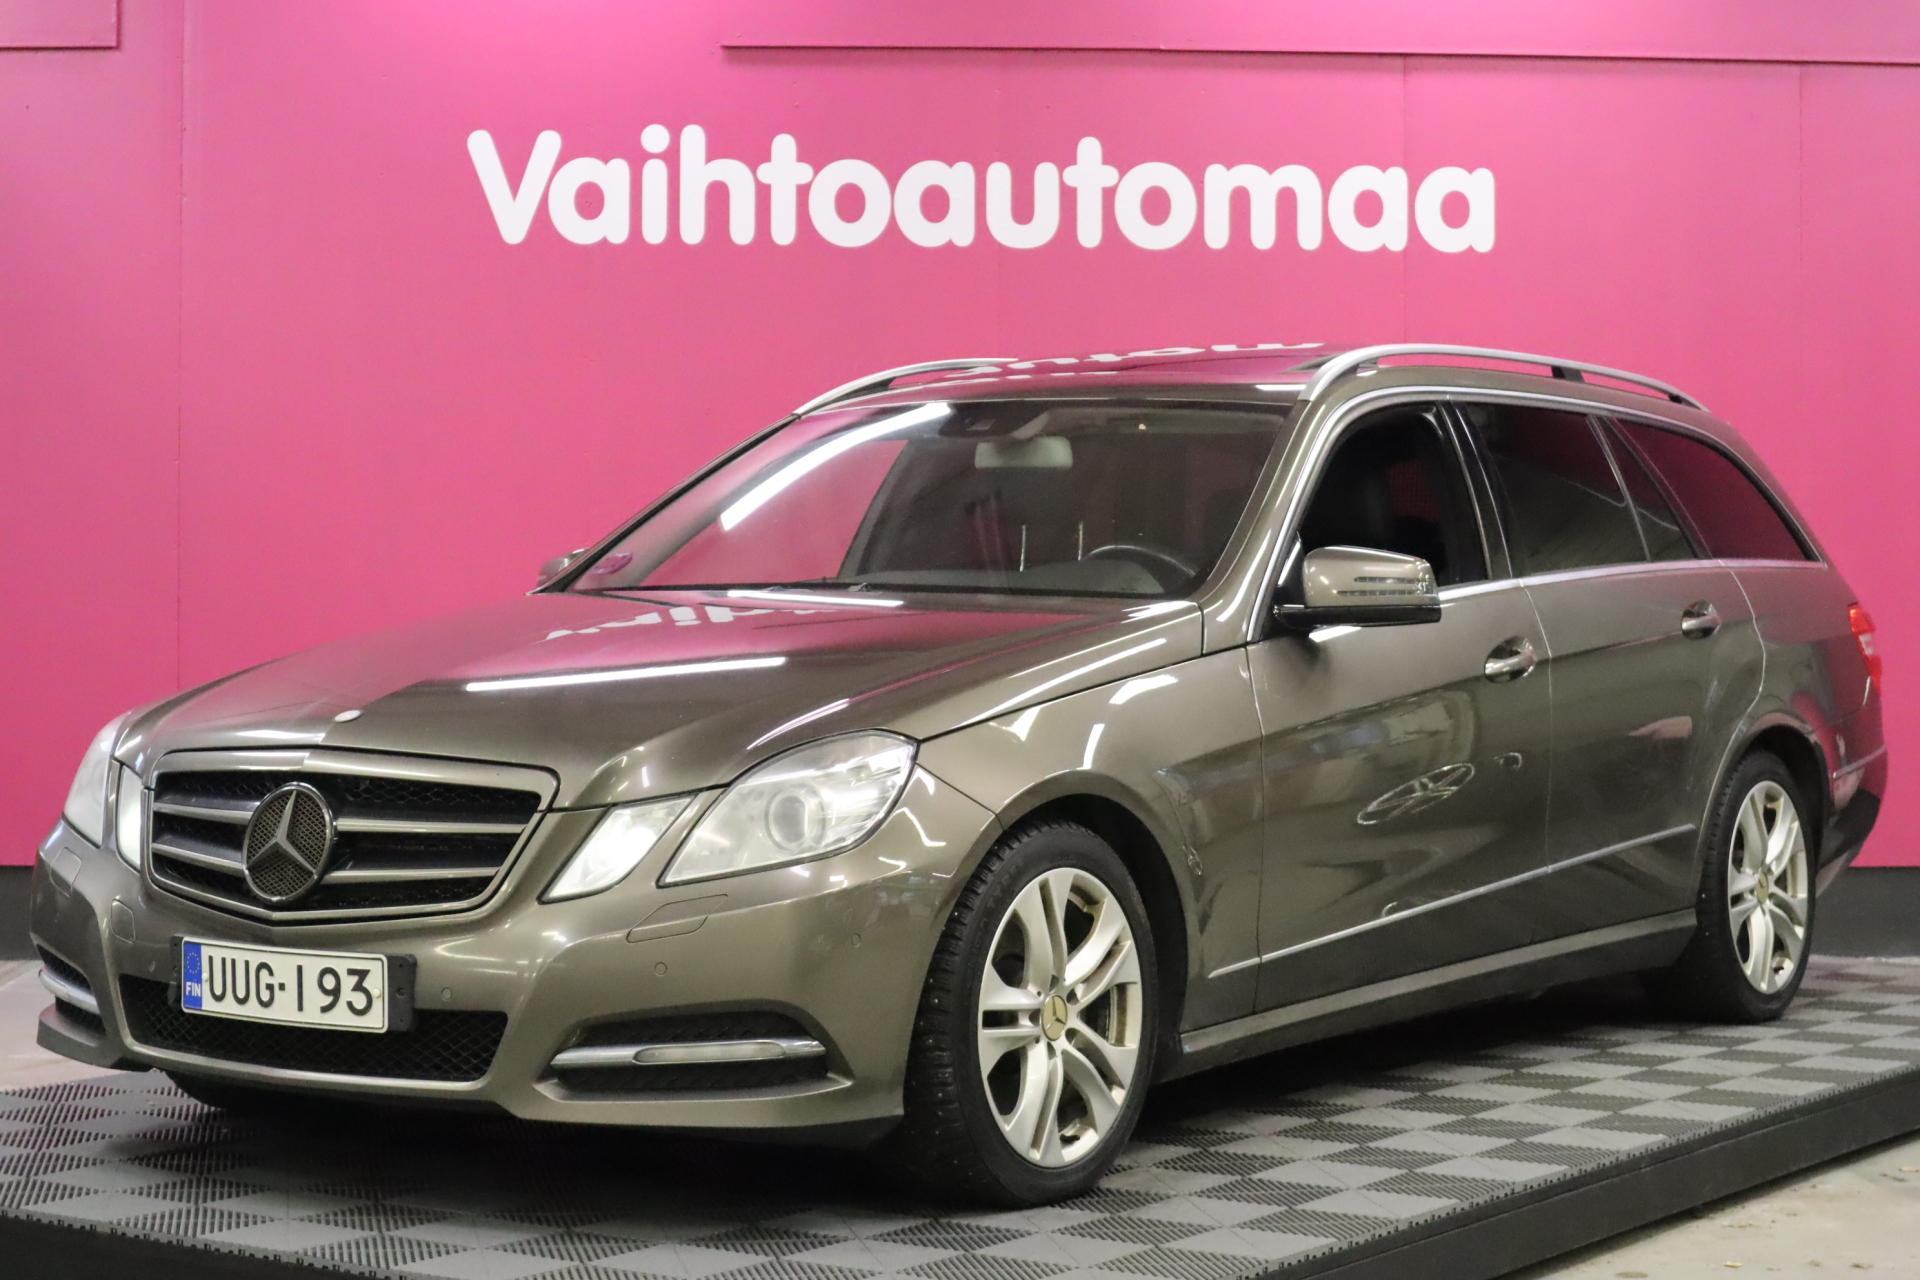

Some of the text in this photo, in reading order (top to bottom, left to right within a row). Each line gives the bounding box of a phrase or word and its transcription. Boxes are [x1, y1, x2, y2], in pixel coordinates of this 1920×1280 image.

[467, 124, 1495, 253] Vaihtoautomaa
[185, 981, 201, 997] FIN
[208, 955, 373, 1016] UUG-193
